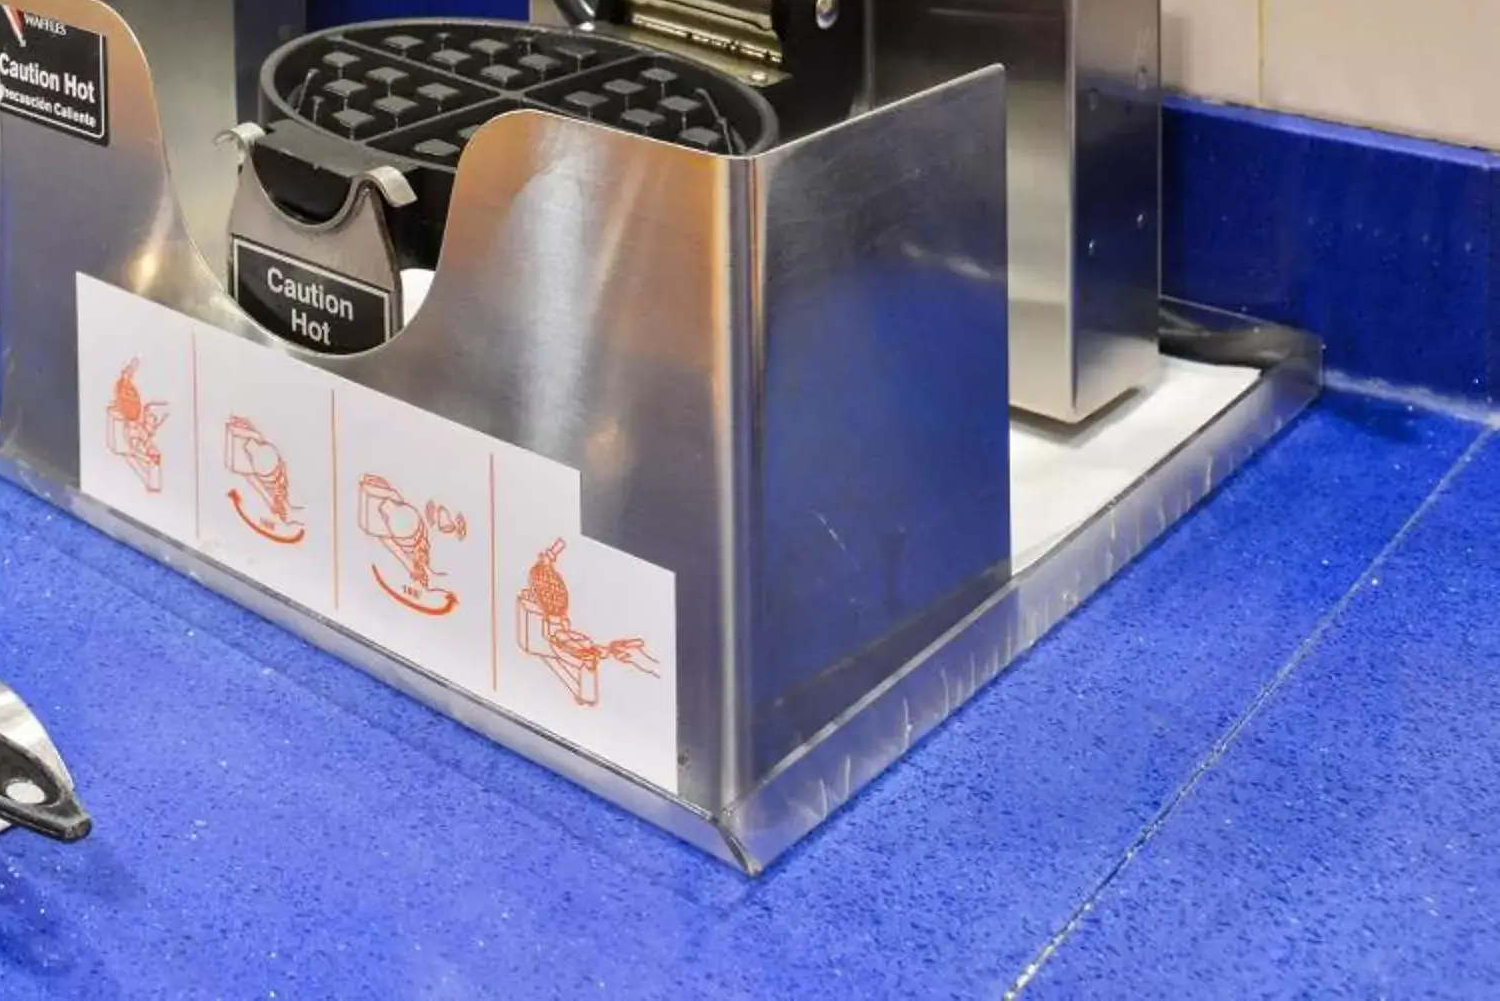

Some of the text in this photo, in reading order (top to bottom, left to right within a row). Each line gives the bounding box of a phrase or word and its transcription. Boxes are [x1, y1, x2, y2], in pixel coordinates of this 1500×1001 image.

[63, 72, 96, 103] Hot
[267, 267, 353, 321] Caution
[291, 308, 331, 345] Hot
